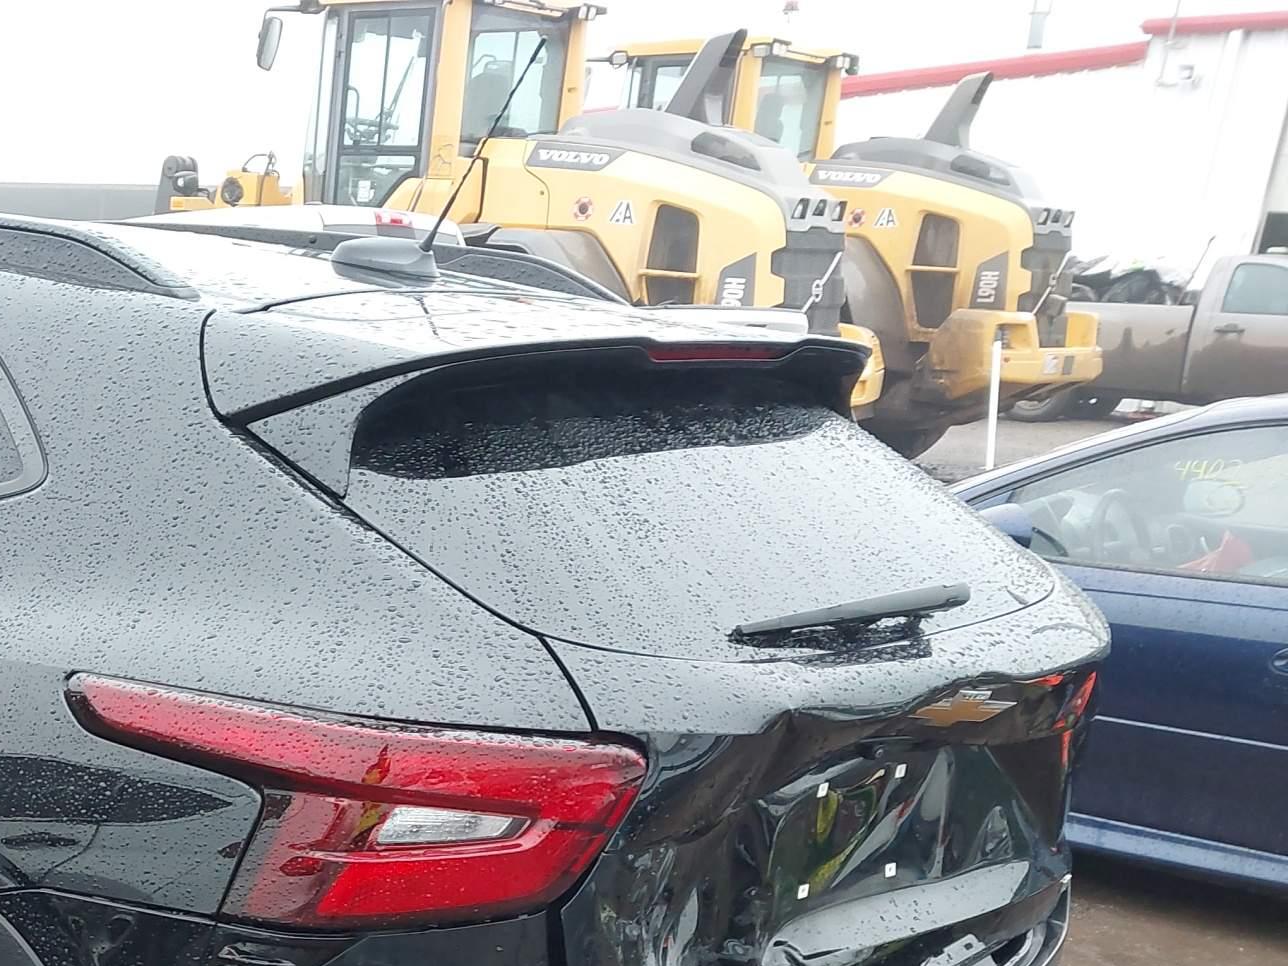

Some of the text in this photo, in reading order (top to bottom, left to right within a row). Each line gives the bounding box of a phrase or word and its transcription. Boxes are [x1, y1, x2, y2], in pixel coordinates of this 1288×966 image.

[538, 148, 610, 165] VOLVO
[817, 169, 881, 183] VOLVO
[976, 271, 1001, 303] L90H
